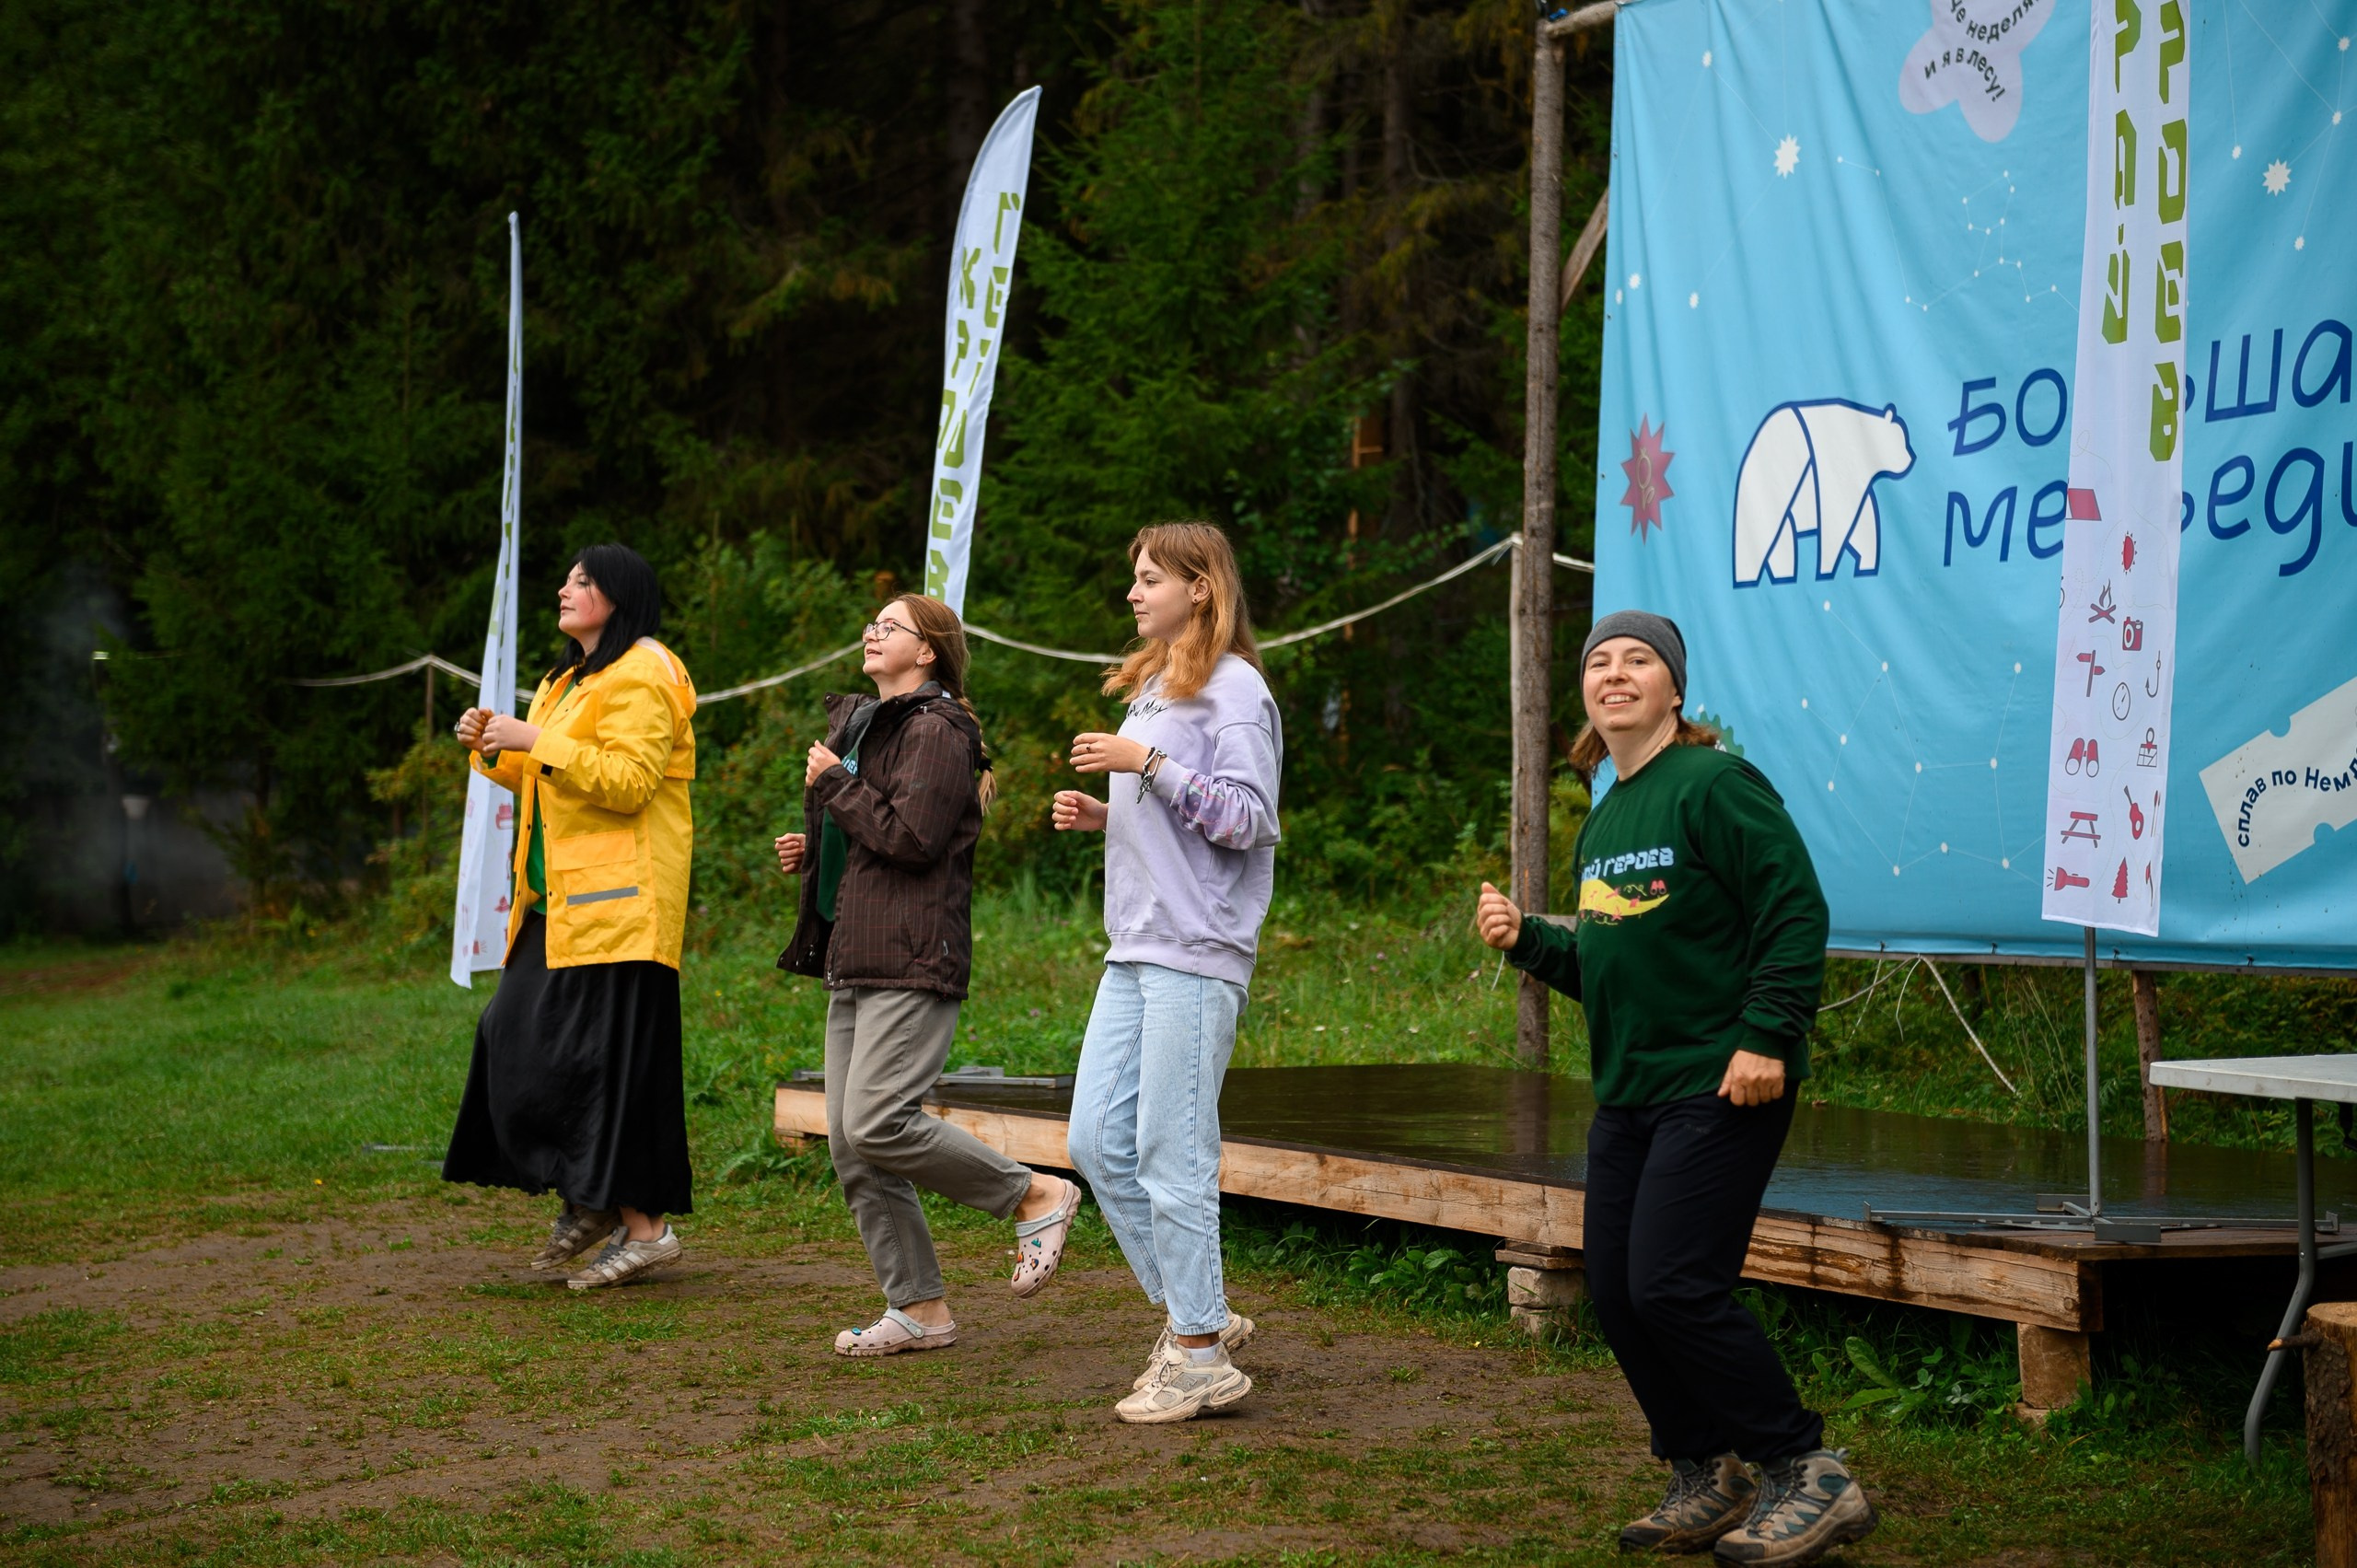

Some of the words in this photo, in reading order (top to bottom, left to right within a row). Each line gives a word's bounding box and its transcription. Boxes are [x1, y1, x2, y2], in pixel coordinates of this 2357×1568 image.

[1924, 60, 1936, 79] и
[1942, 51, 1950, 68] я
[1956, 47, 1964, 63] в
[1967, 50, 2005, 102] лесу!
[937, 246, 981, 449] КРА
[2238, 777, 2267, 847] сплав
[2271, 770, 2297, 786] по
[1603, 846, 1674, 877] ГЕРОЕВ
